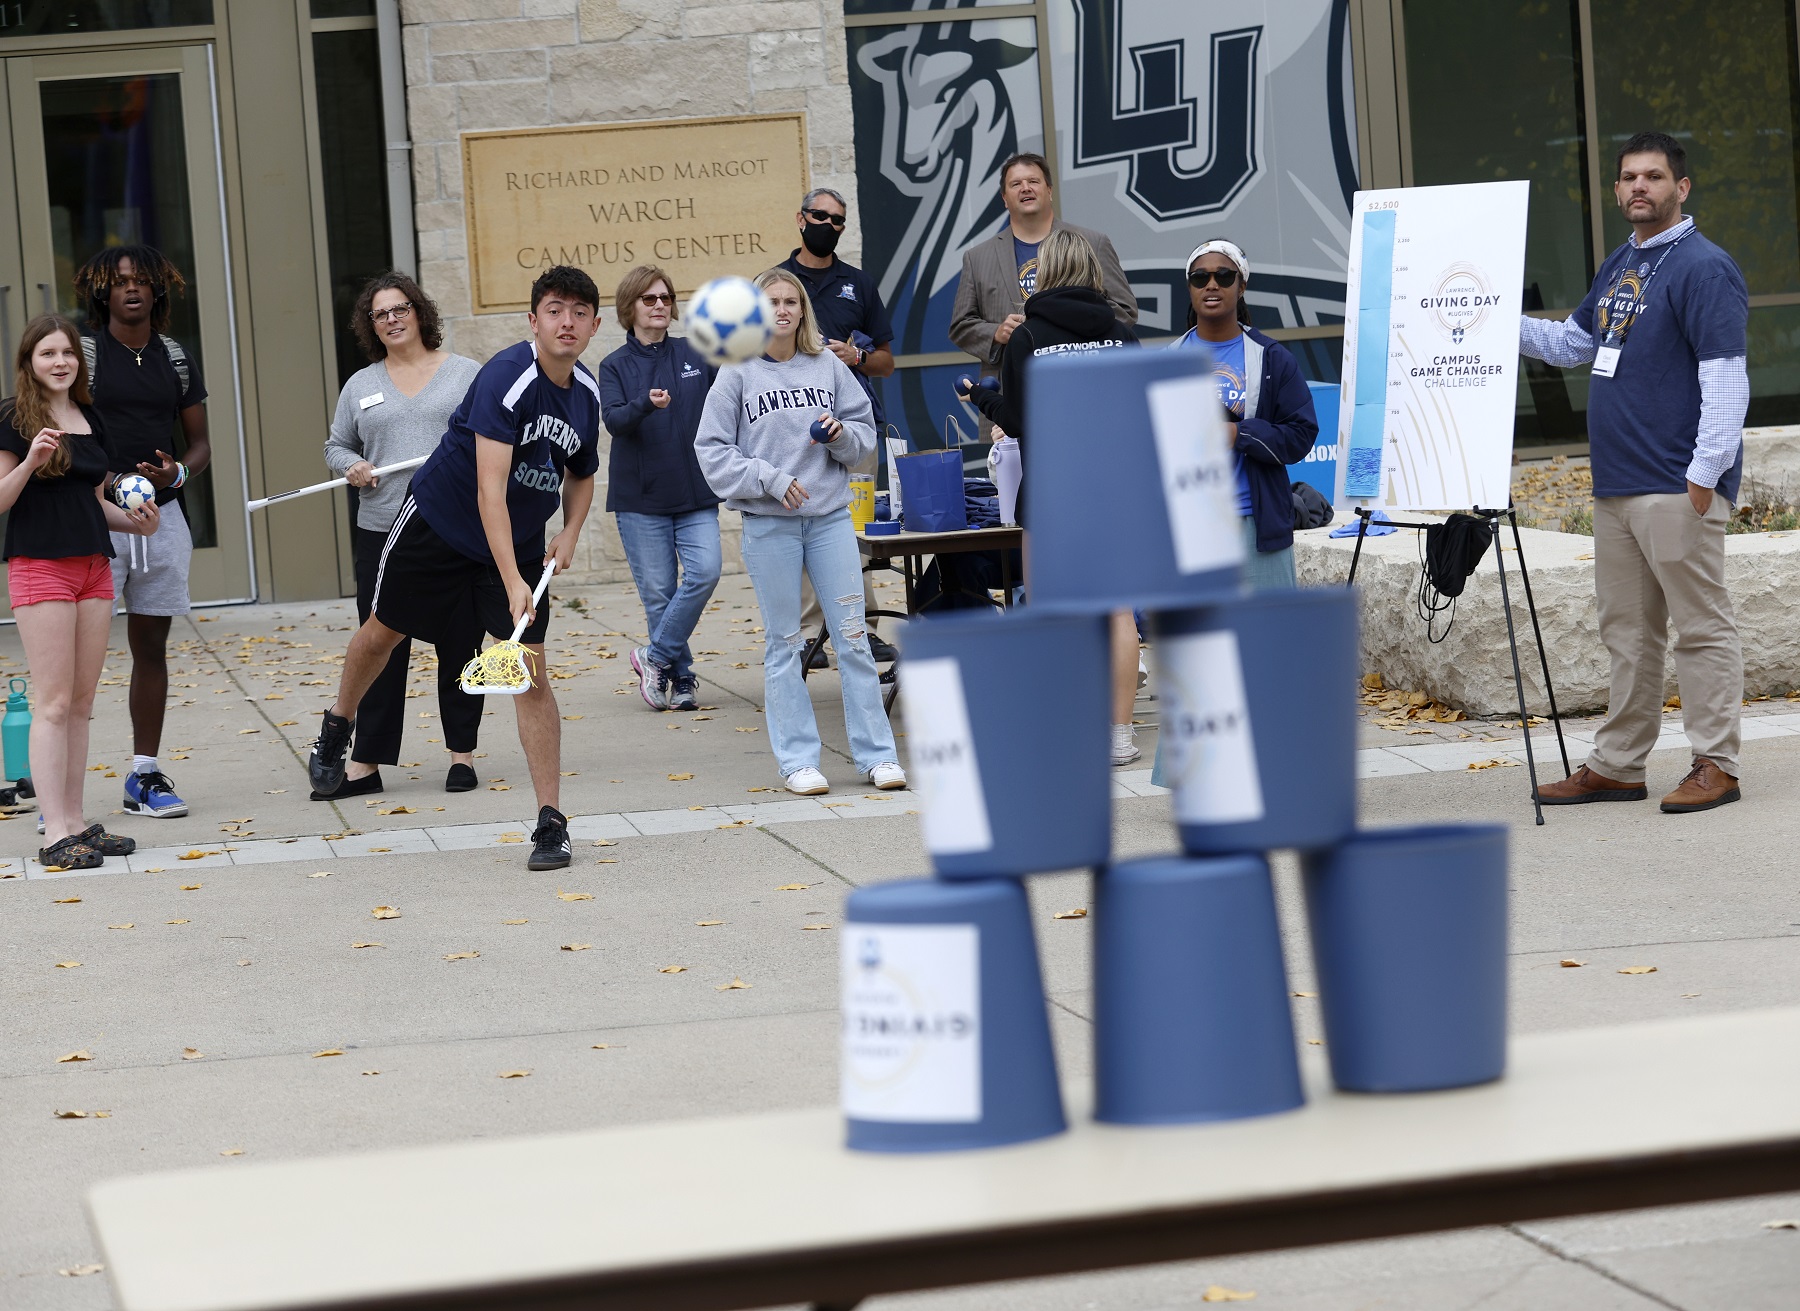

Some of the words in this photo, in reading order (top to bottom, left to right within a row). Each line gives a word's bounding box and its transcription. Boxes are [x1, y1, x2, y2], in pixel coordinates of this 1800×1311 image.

[1071, 0, 1264, 222] LU
[505, 168, 610, 191] RICHARD
[617, 165, 665, 184] AND
[673, 158, 769, 181] MARGOT
[588, 197, 696, 224] WARCH
[1368, 201, 1399, 210] $2,500
[517, 240, 635, 269] CAMPUS
[653, 232, 767, 260] CENTER
[1420, 296, 1468, 308] GIVING
[1474, 295, 1501, 306] DAY
[1598, 296, 1626, 311] GIVNG
[1115, 339, 1123, 348] 2
[1433, 355, 1481, 366] CAMPUS
[1410, 366, 1442, 377] GAME
[1447, 365, 1503, 376] CHANGER
[1424, 376, 1487, 389] CHALLENGE
[744, 387, 835, 425] LAWRENCE
